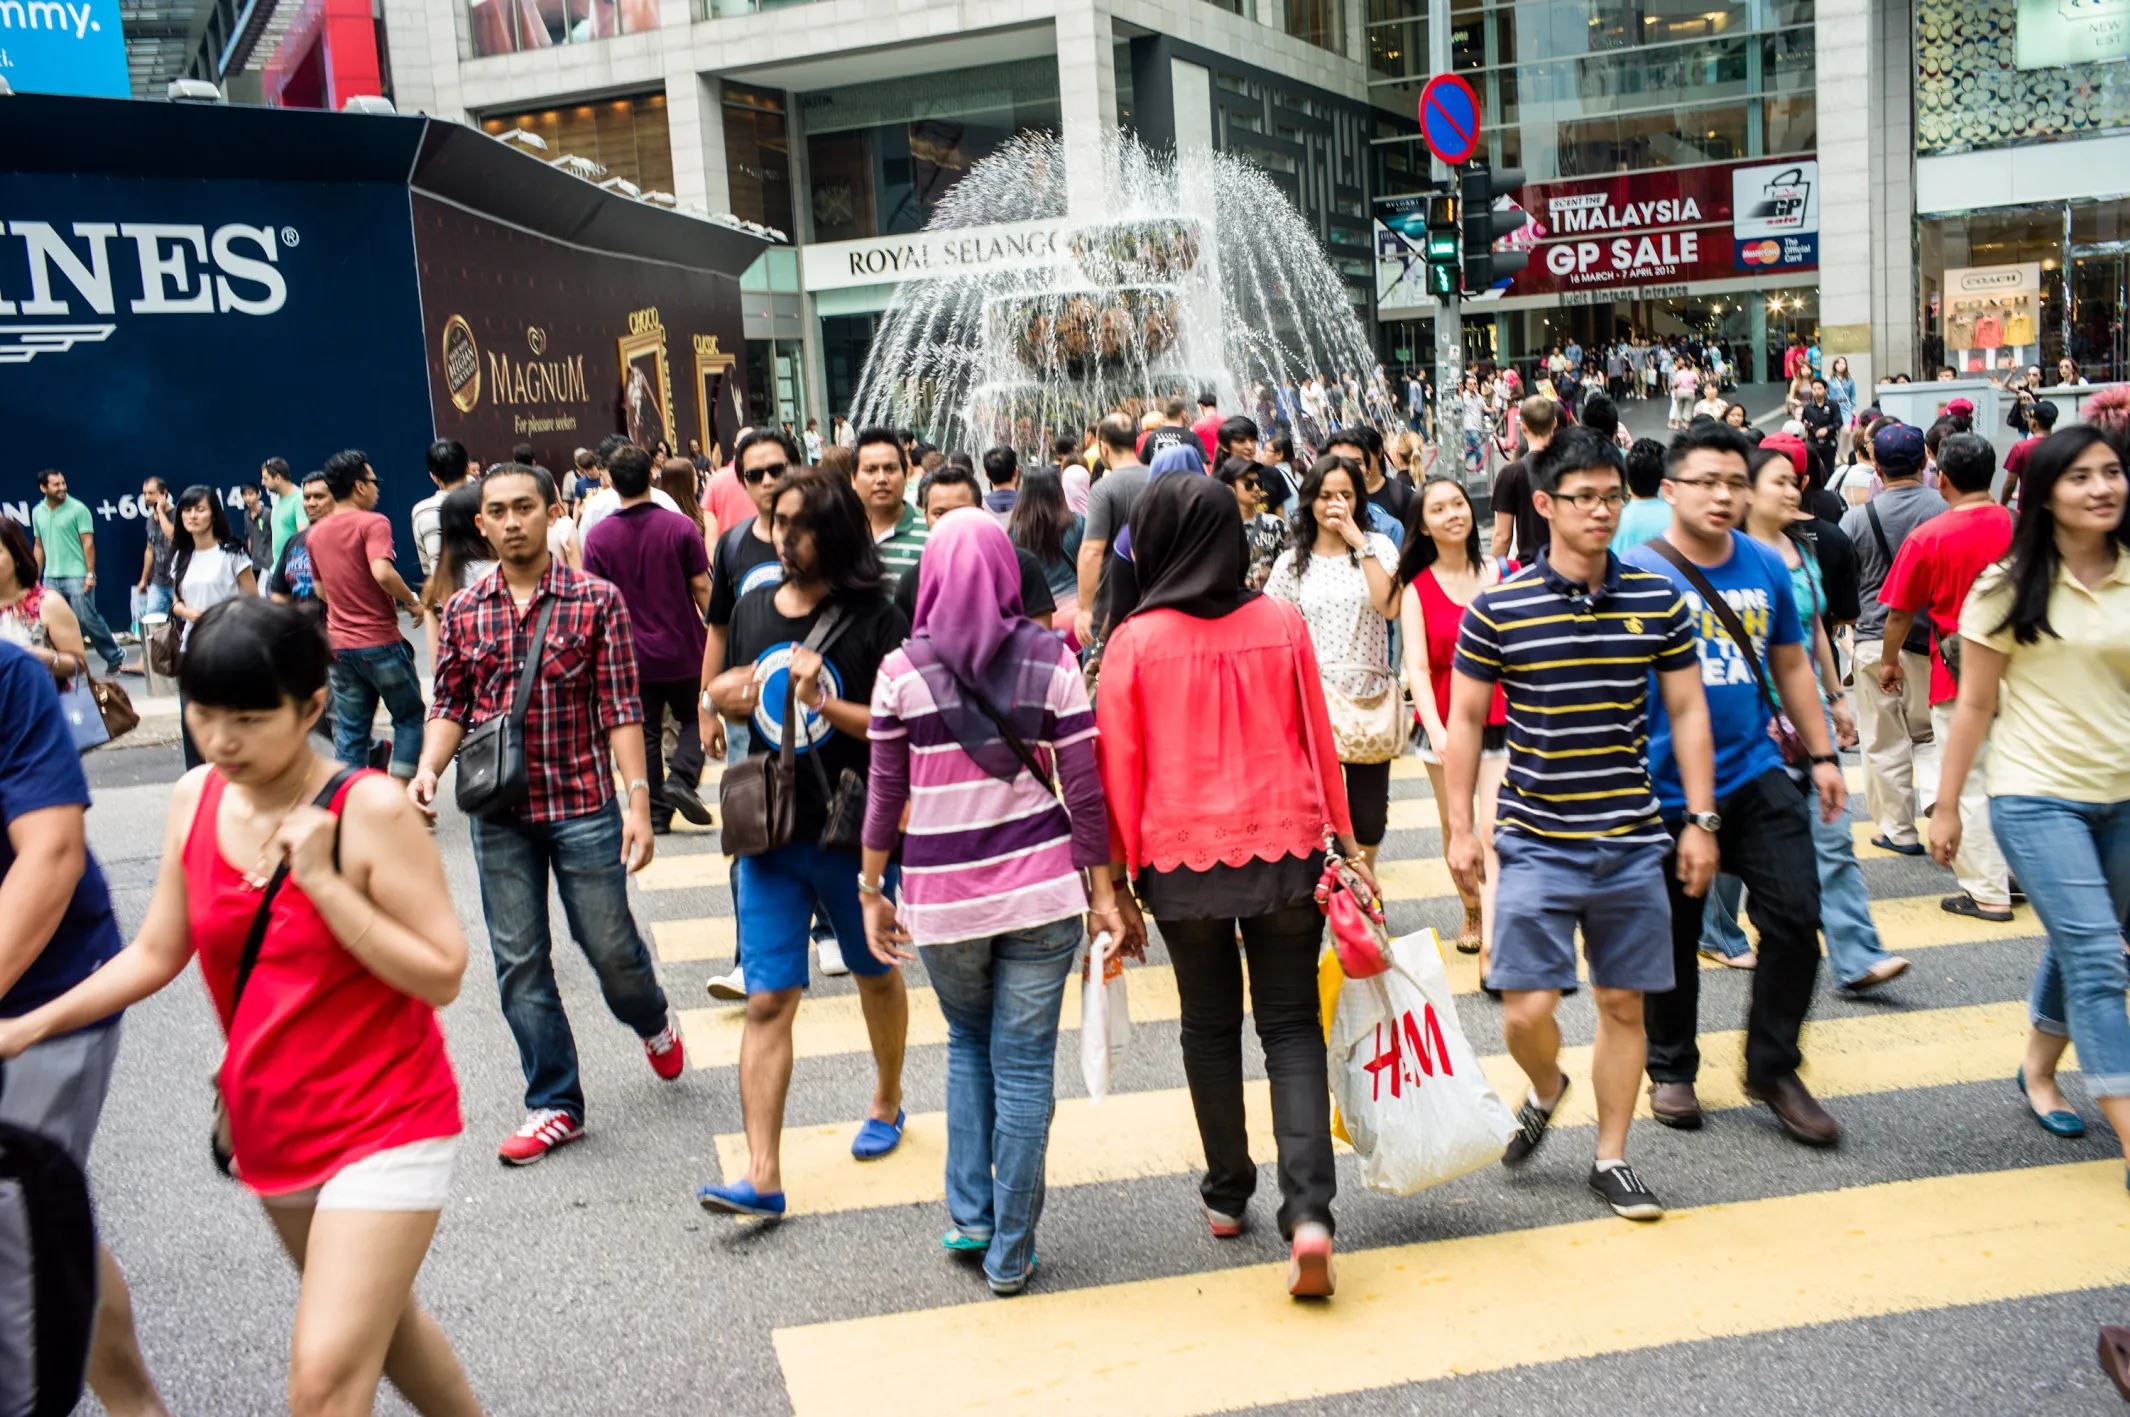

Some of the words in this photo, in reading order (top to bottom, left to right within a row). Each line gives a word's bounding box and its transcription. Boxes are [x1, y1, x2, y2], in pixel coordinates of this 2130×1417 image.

[1550, 197, 1702, 234] 1MALAYSIA
[1784, 237, 1799, 246] The
[849, 243, 933, 277] ROYAL
[1546, 242, 1600, 276] GP
[1611, 231, 1699, 270] SALE
[1784, 254, 1803, 263] Card
[1570, 274, 1580, 284] 16
[1581, 271, 1614, 283] MARCH
[1629, 266, 1653, 278] APRIL
[1654, 265, 1676, 276] 2013
[1966, 274, 2017, 286] COACH
[1559, 291, 1589, 306] Bukit
[1591, 289, 1635, 304] Bintang
[1639, 285, 1689, 300] Entrance
[628, 306, 659, 336] CHOCO
[693, 333, 719, 355] CLASSIC
[514, 414, 527, 434] For
